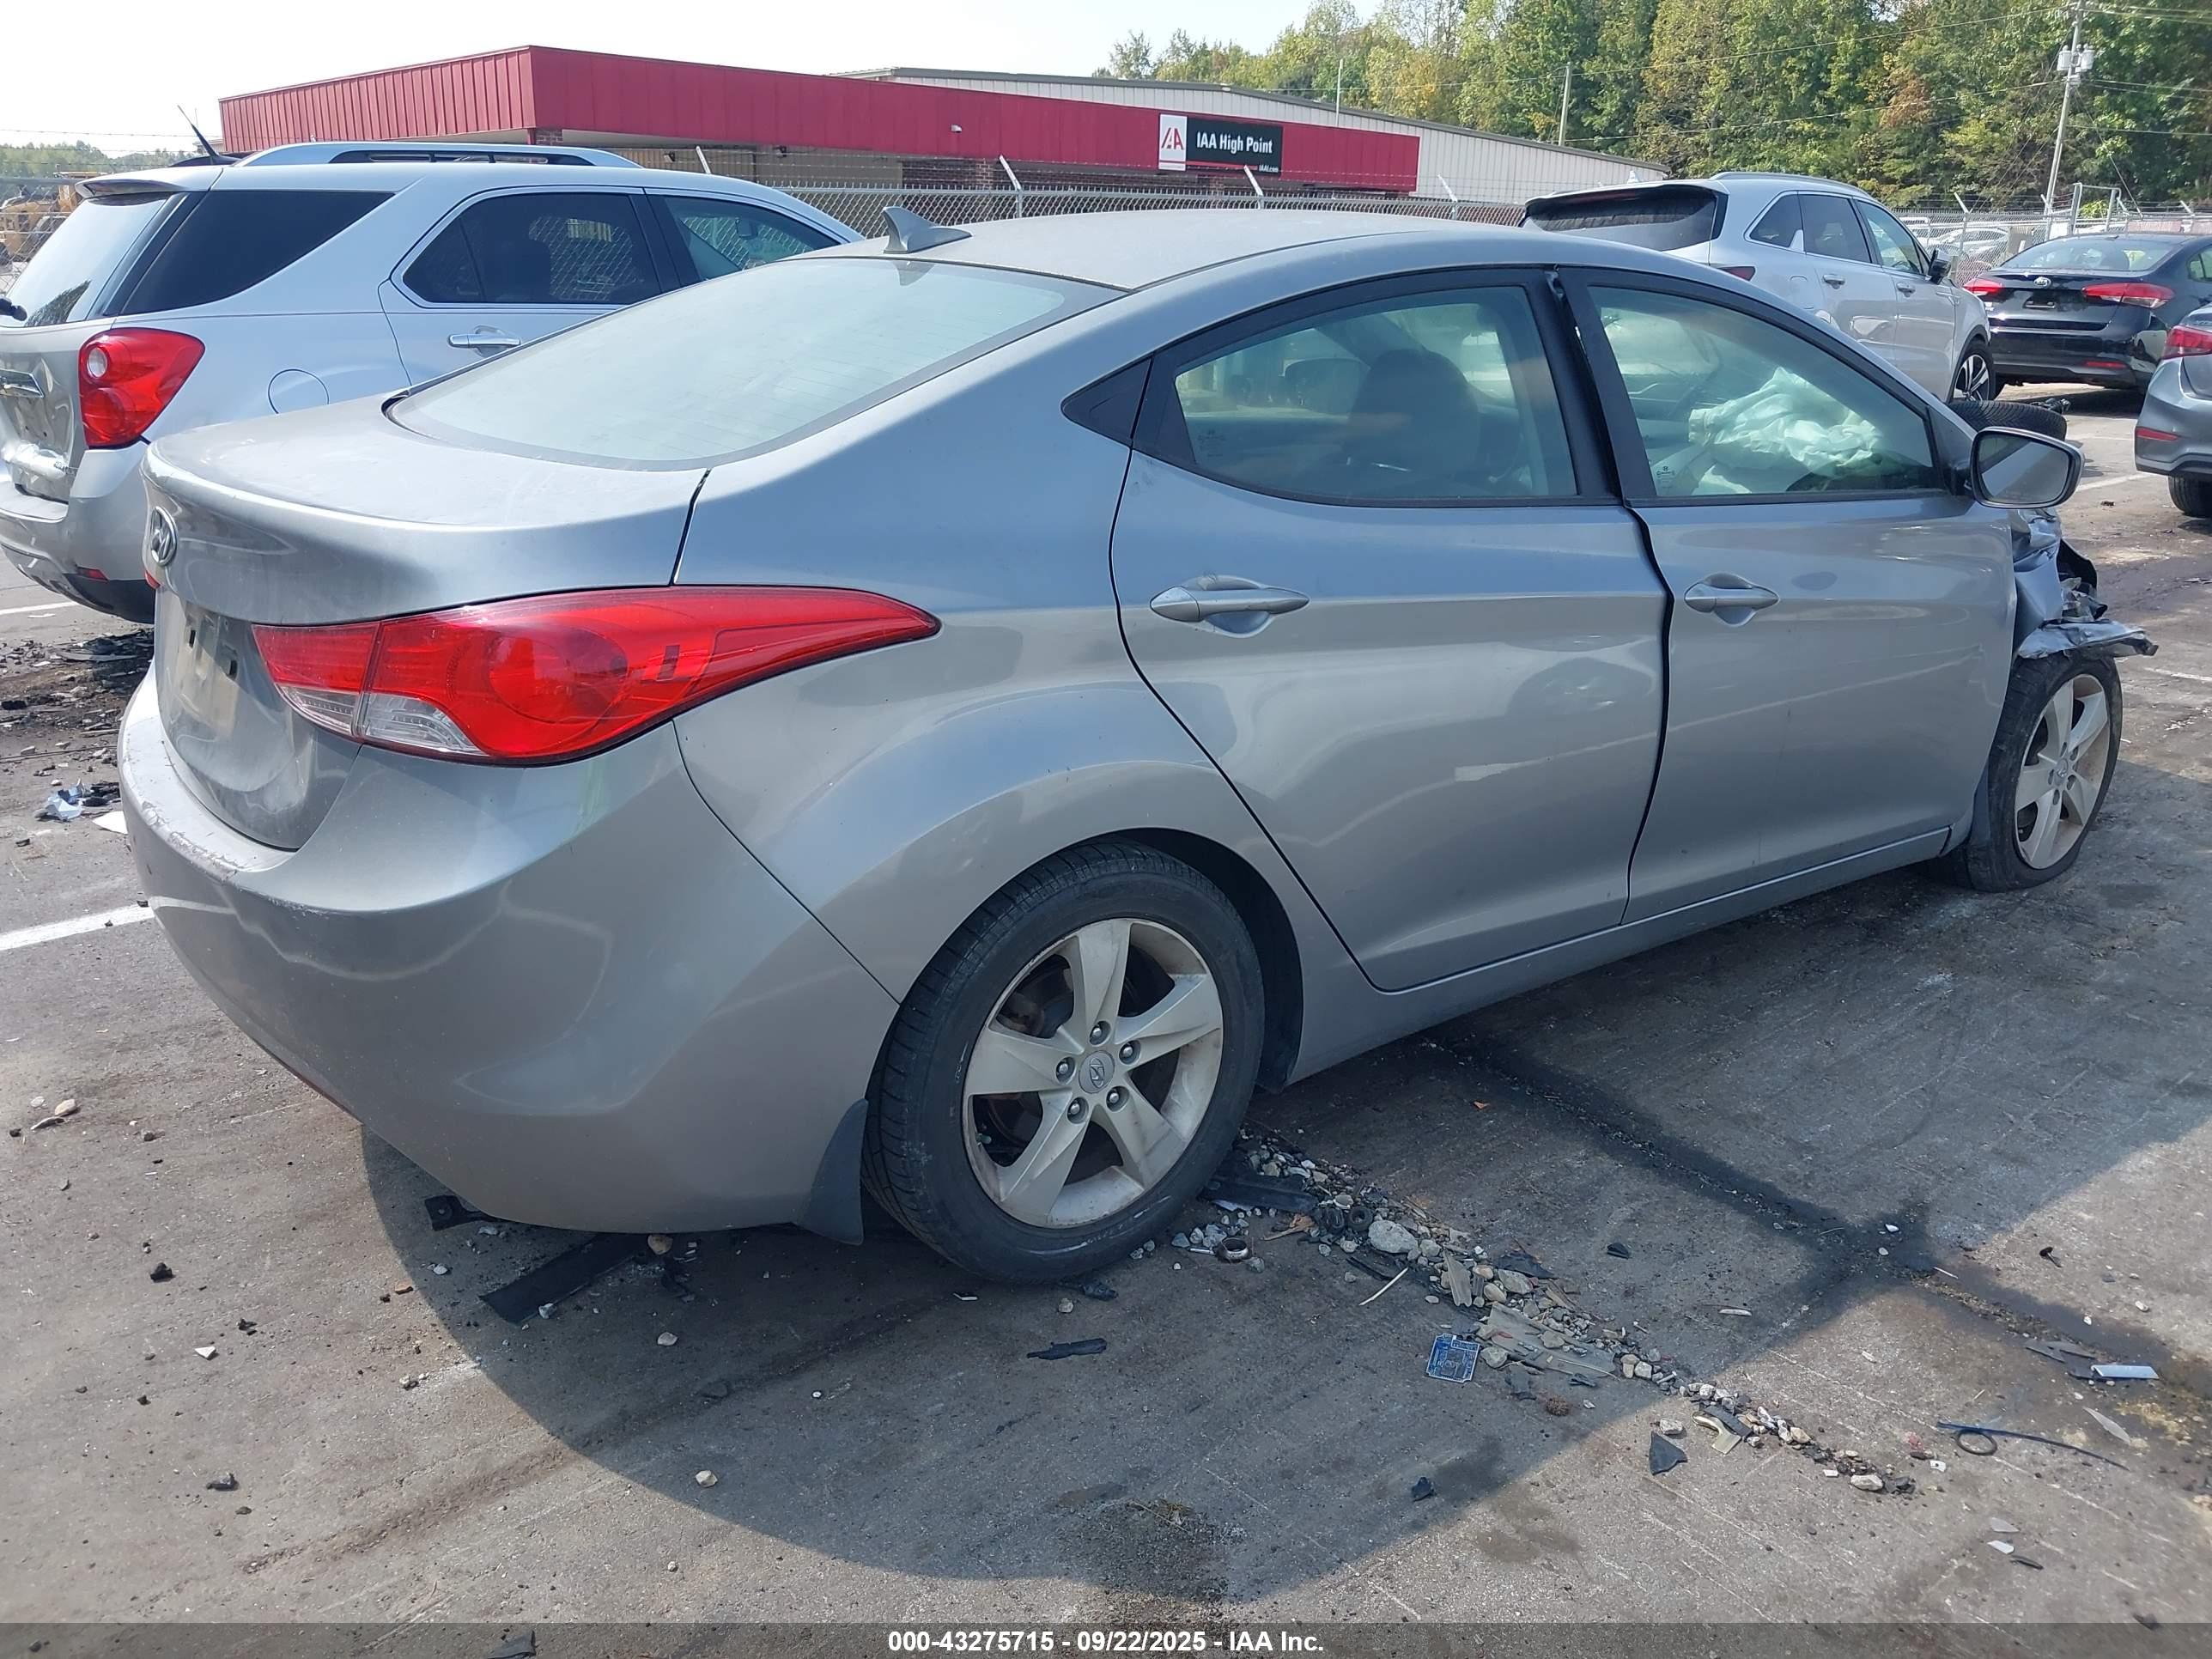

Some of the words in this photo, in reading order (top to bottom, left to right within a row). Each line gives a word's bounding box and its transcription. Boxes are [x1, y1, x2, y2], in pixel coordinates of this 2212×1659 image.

[1196, 131, 1217, 149] IAA
[1219, 134, 1243, 154] High
[1246, 137, 1273, 154] Point
